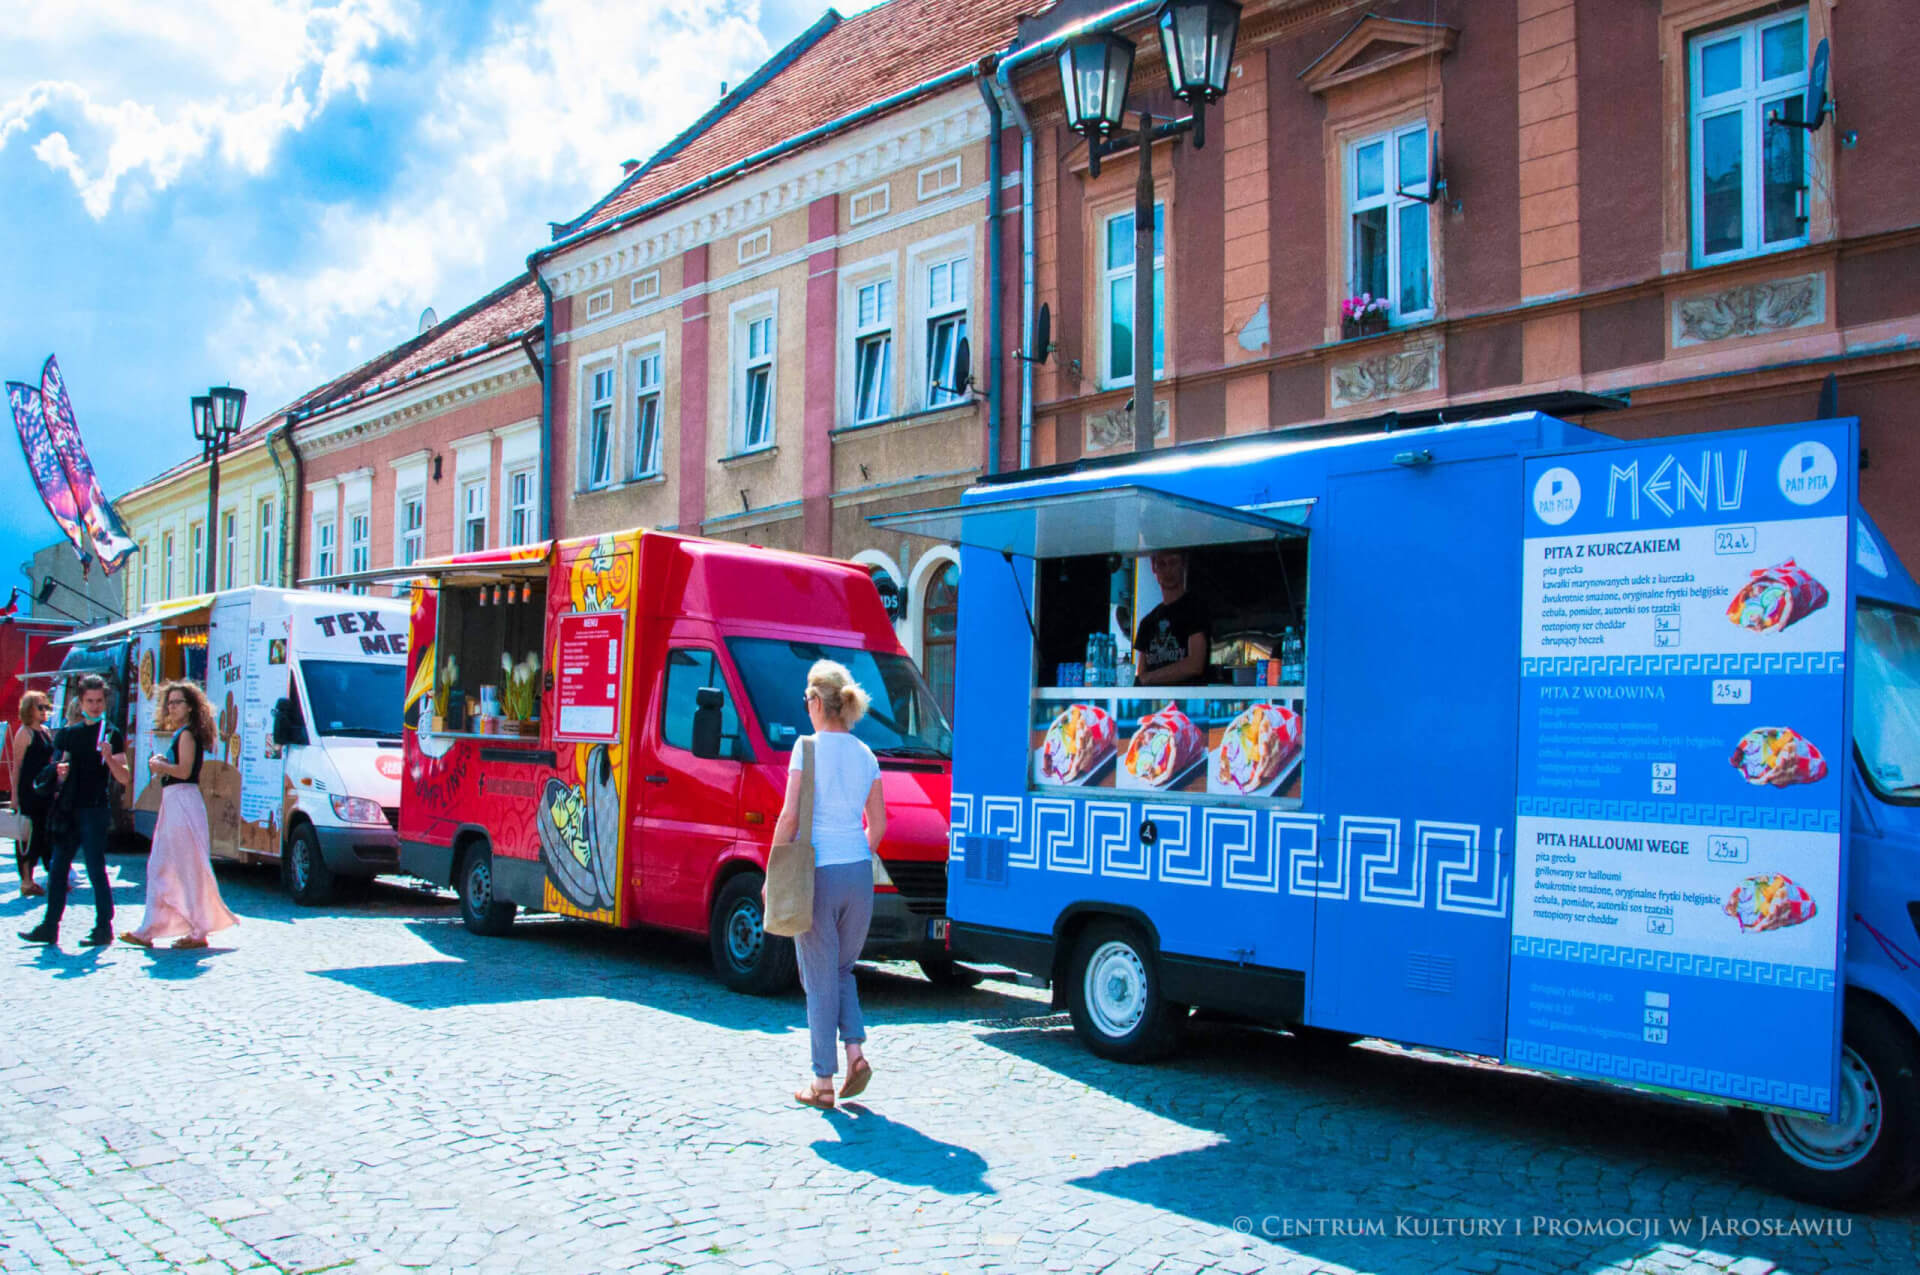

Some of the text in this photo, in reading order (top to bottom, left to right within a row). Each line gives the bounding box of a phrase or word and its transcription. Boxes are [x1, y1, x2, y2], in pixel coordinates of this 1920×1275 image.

[1606, 449, 1748, 520] MENU
[1785, 474, 1829, 493] PAN PITA
[1556, 497, 1575, 512] PITA
[1544, 537, 1681, 560] PITA Z KURCZAKIEM
[1658, 572, 1695, 584] kurczaka
[314, 610, 386, 637] TEX
[359, 633, 409, 656] ME
[217, 651, 233, 672] TEX
[224, 664, 241, 685] MEX
[1540, 686, 1570, 699] PITA
[1571, 686, 1582, 699] Z
[1536, 832, 1690, 855] PITA HALLOUMI WEGE
[1535, 852, 1550, 863] pita
[1630, 903, 1643, 913] sos
